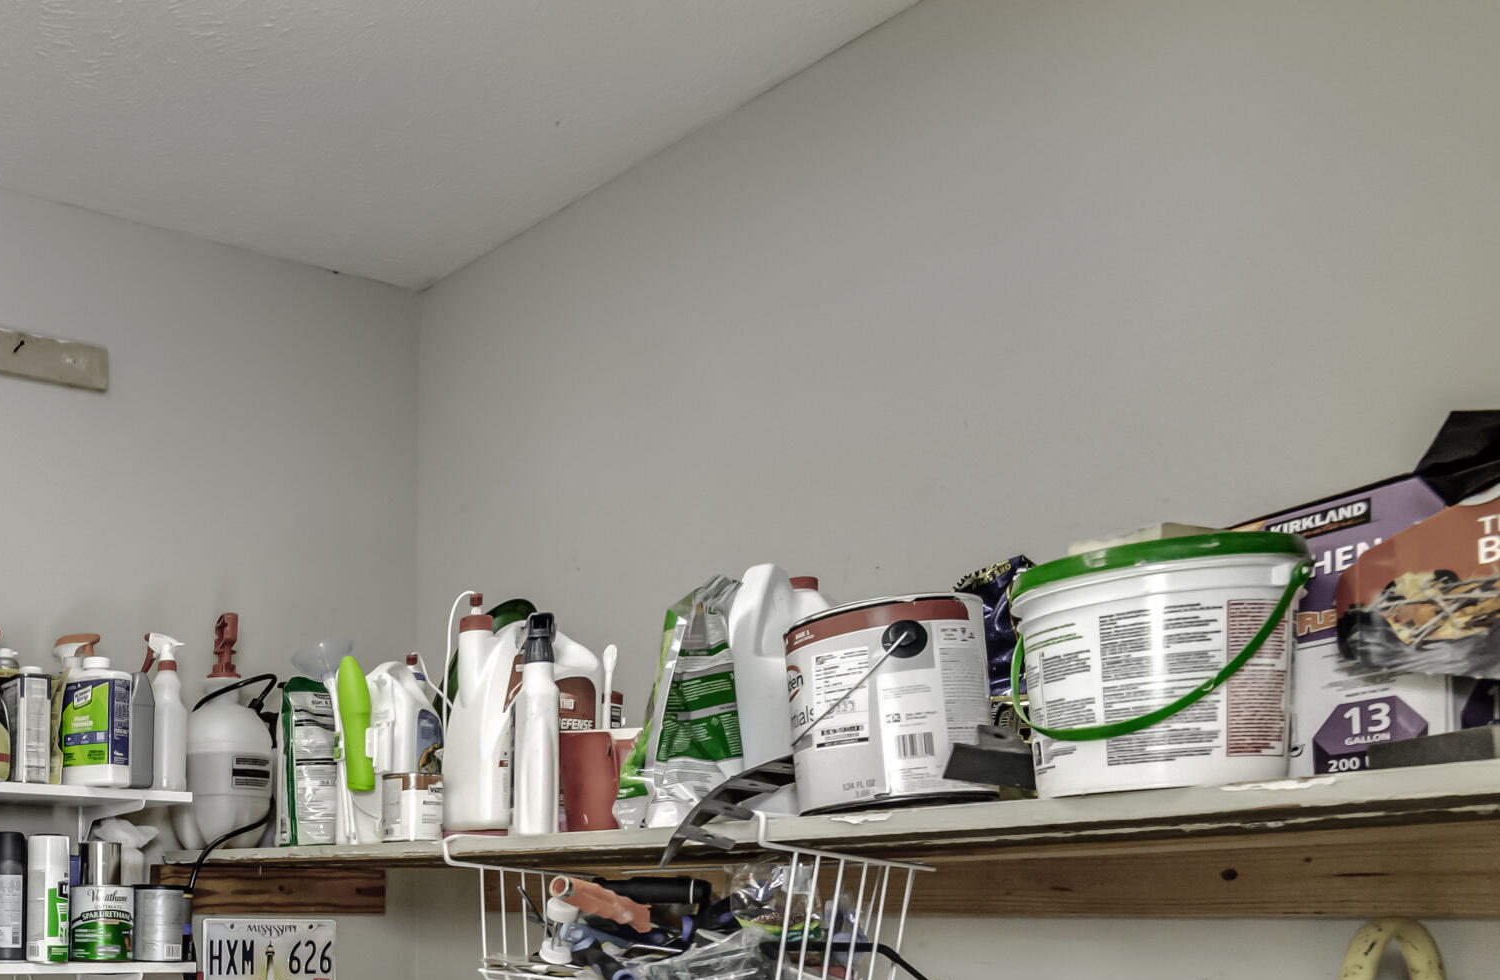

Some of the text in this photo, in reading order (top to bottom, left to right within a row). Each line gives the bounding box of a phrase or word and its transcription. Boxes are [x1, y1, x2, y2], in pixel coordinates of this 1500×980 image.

[1270, 501, 1368, 534] KIRKLAND
[1477, 514, 1500, 534] T
[559, 717, 594, 730] EFENSE
[1343, 702, 1391, 735] 13
[1345, 732, 1391, 746] GALLON
[1328, 757, 1360, 773] 200
[247, 923, 297, 937] MISSISSIPPI
[209, 940, 333, 975] HXM 626
